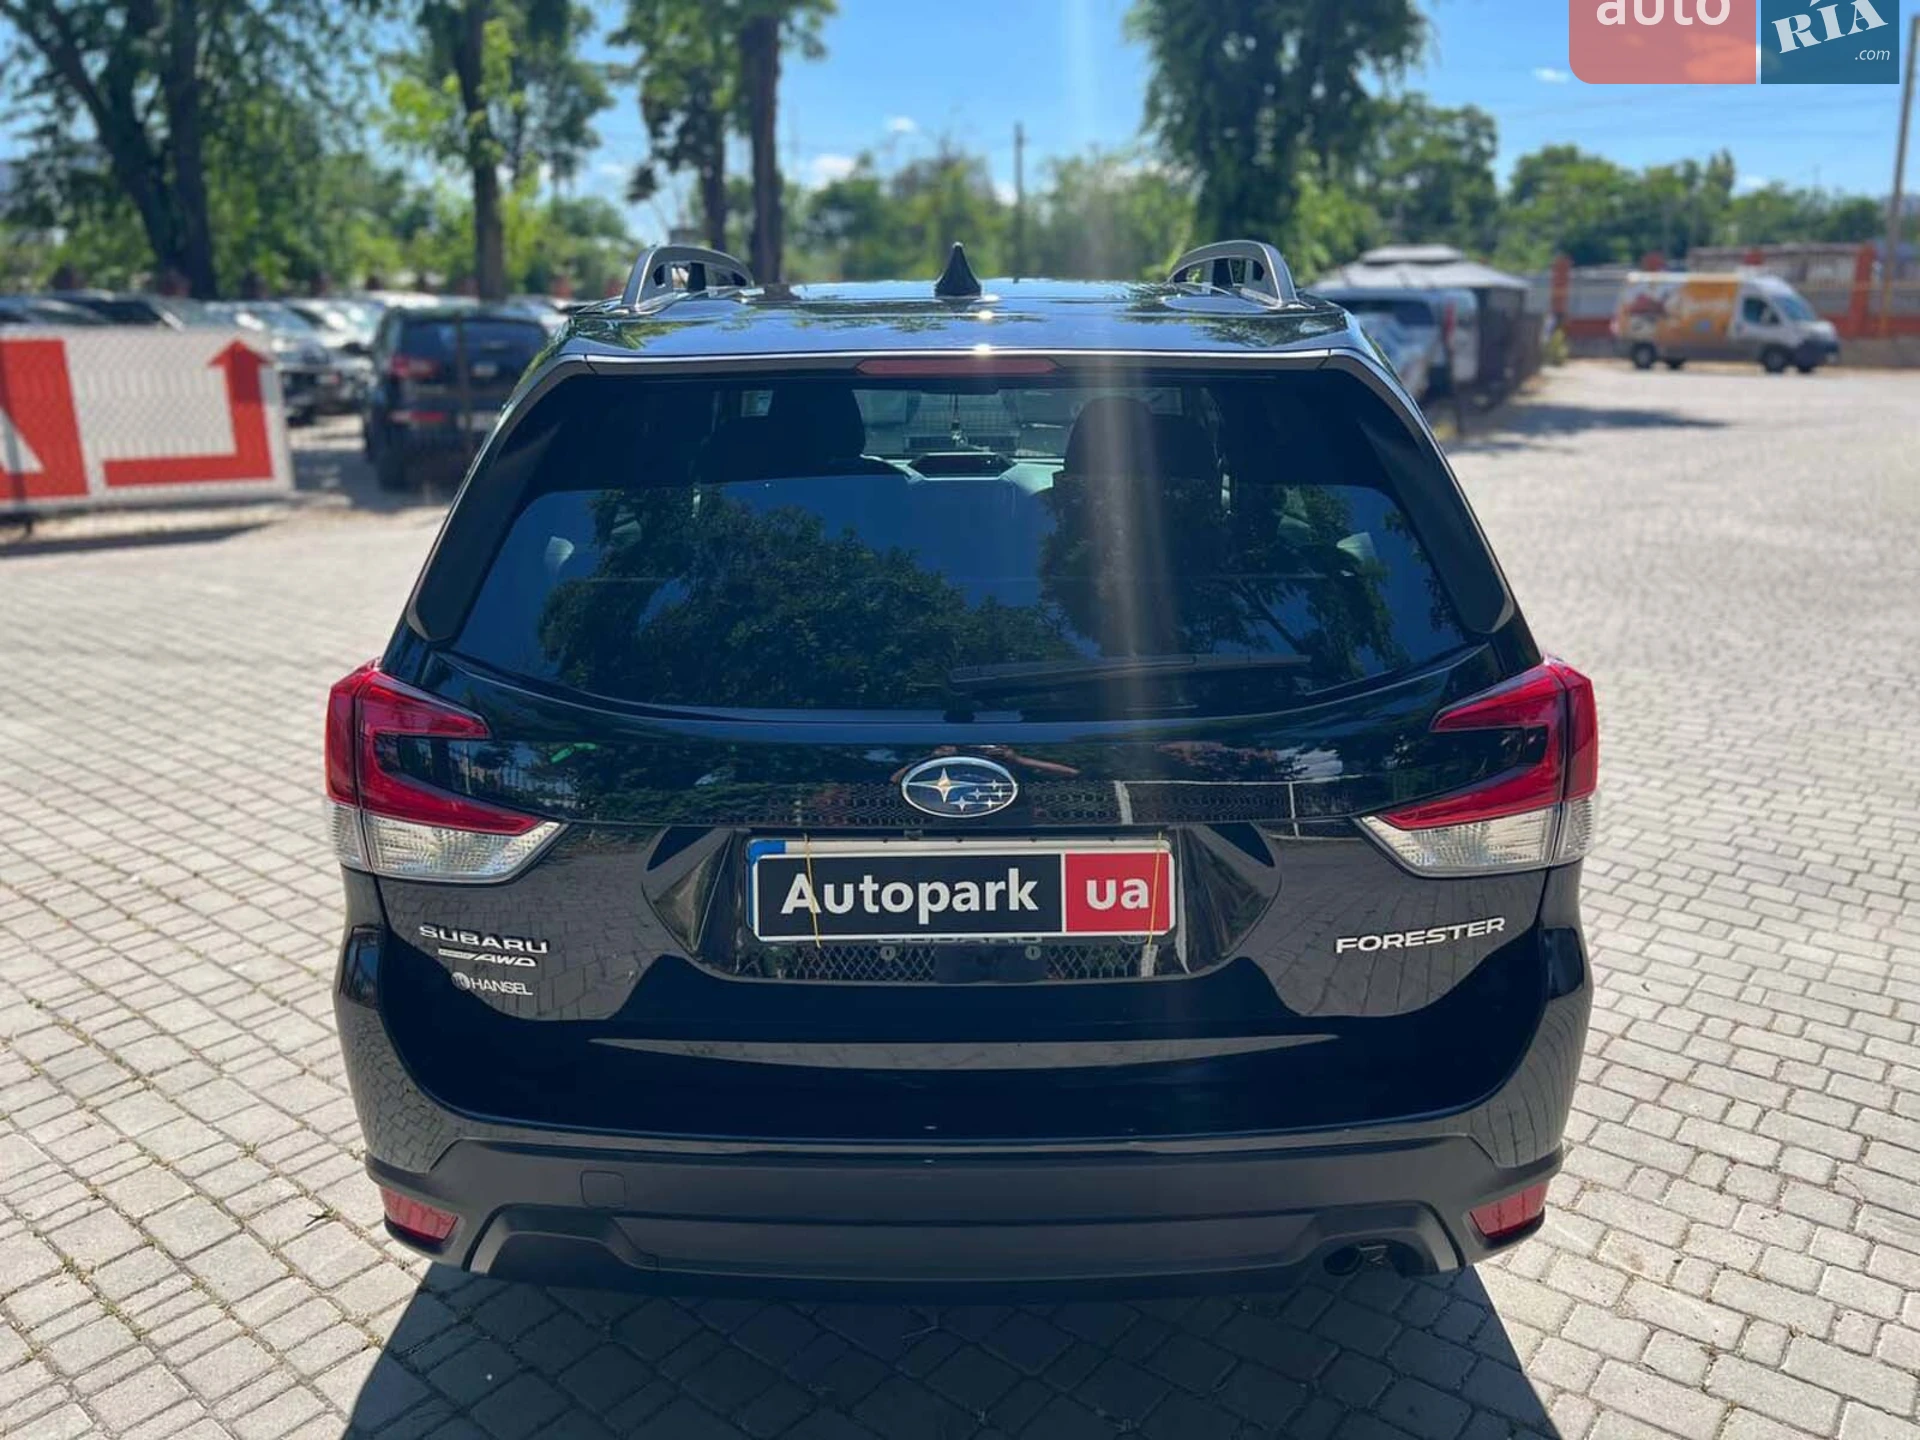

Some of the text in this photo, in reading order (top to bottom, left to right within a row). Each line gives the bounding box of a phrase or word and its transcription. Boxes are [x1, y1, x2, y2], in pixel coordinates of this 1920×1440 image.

[780, 867, 1151, 925] Autopark ua
[418, 925, 549, 954] SUBARU
[1336, 916, 1506, 954] FORESTER
[473, 953, 537, 967] AWD
[470, 977, 534, 995] HANSEL
